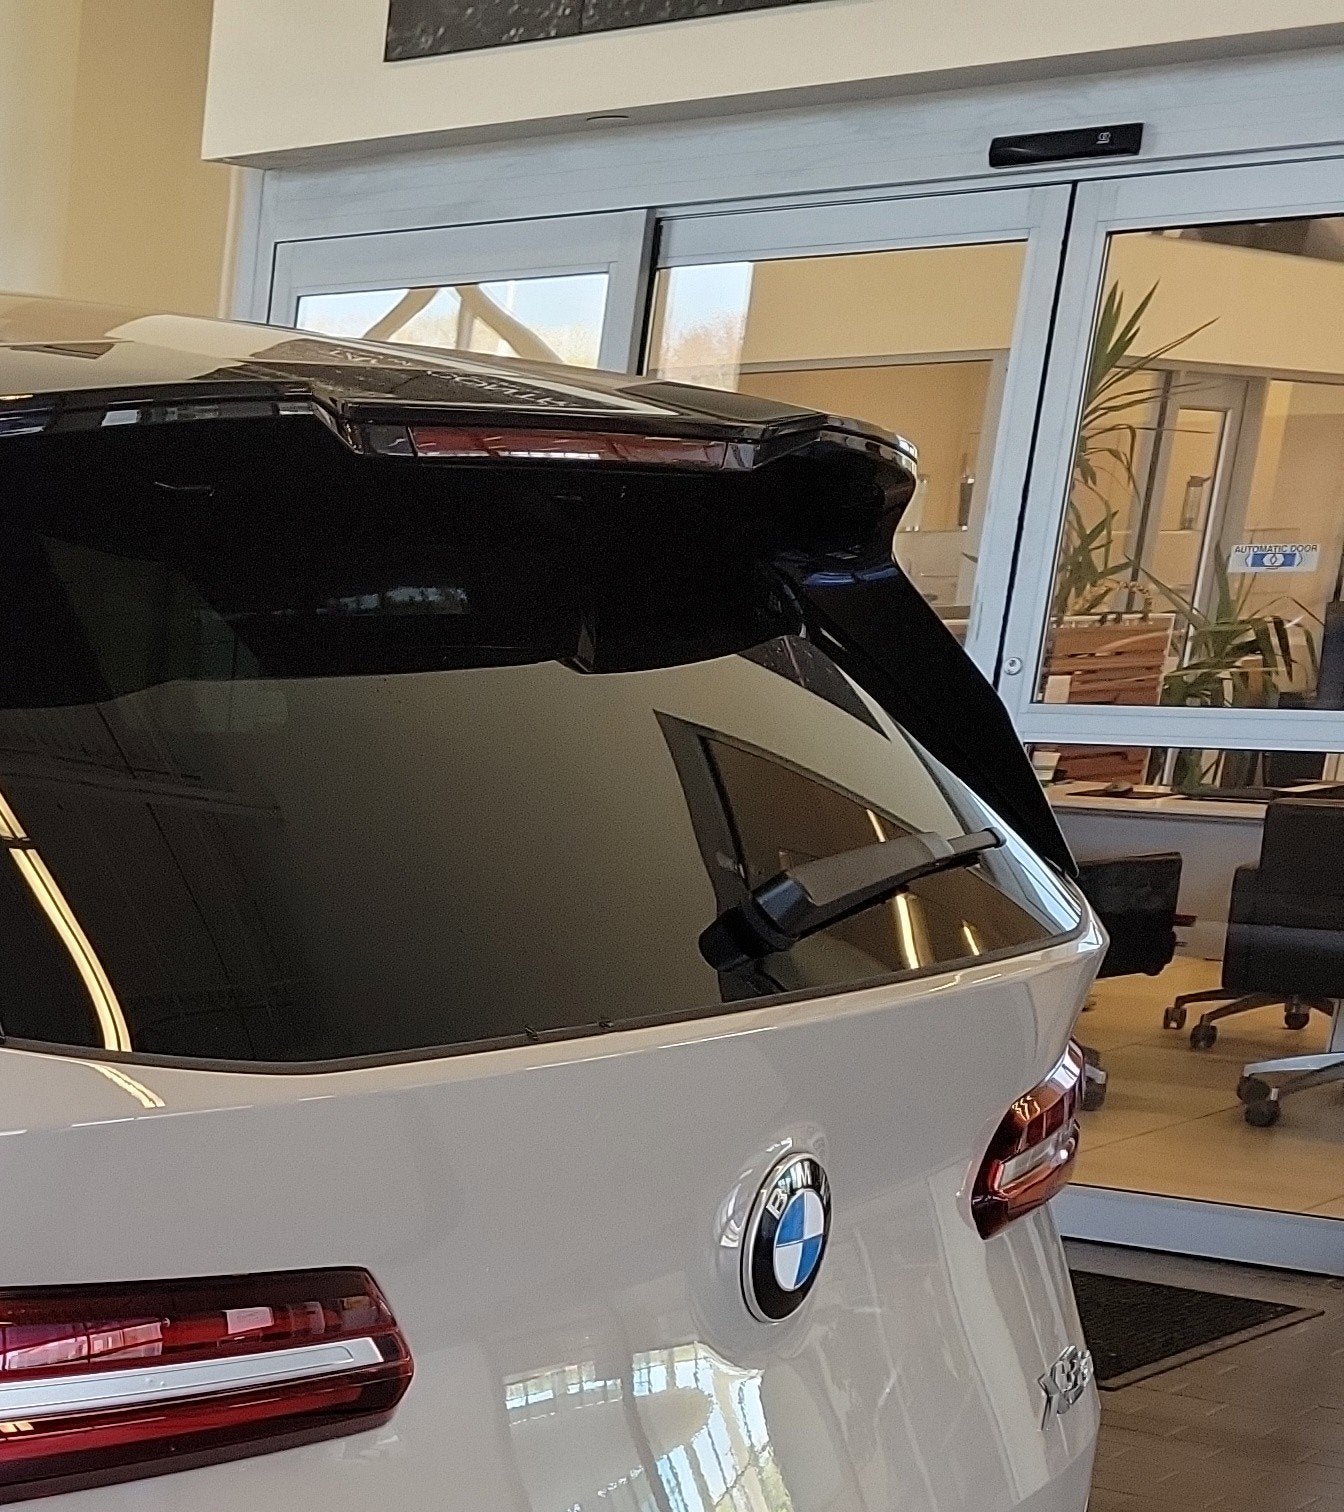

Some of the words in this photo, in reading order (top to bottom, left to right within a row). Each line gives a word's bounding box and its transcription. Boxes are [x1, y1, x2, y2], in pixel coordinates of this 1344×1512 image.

[1235, 545, 1289, 554] AUTOMATIC
[1291, 545, 1318, 553] DOOR
[765, 1159, 831, 1221] BMW
